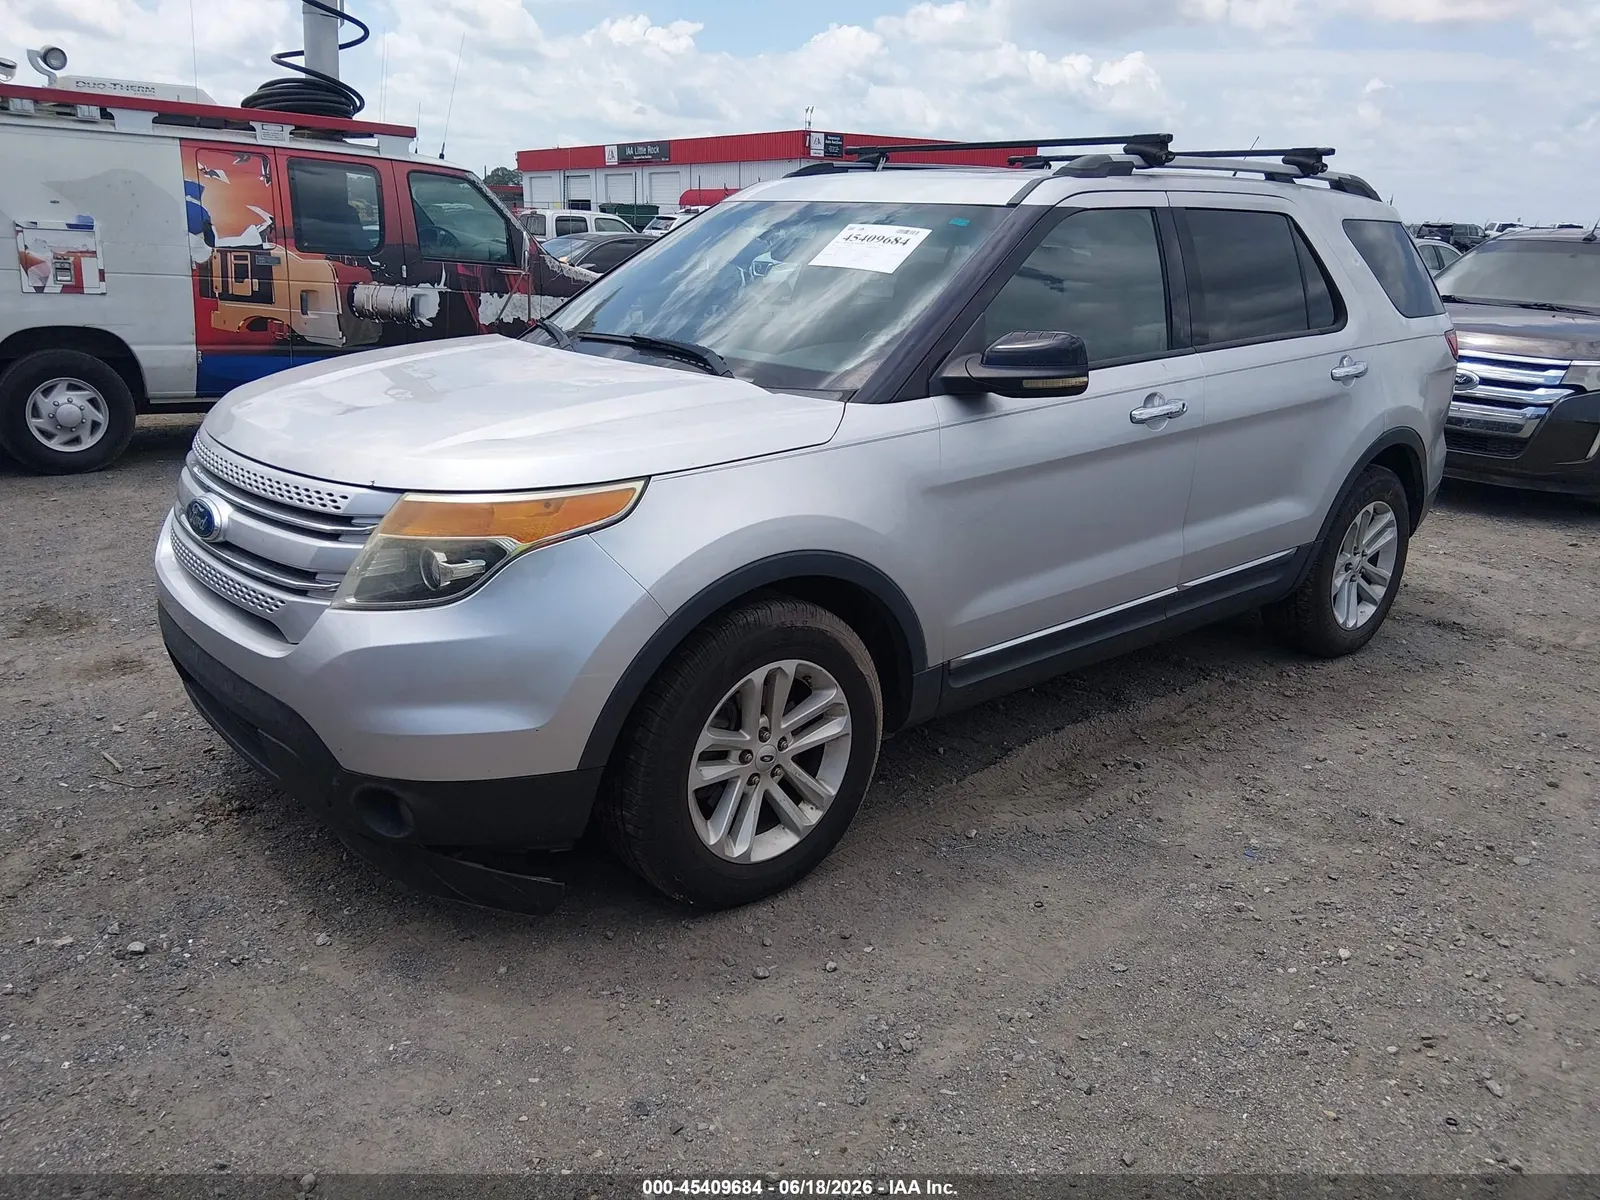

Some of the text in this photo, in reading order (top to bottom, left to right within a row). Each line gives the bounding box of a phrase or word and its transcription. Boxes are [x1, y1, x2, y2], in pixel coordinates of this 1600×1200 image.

[634, 146, 646, 154] Little
[648, 145, 660, 154] Rock
[843, 233, 911, 246] 45409684
[190, 503, 208, 530] Ford
